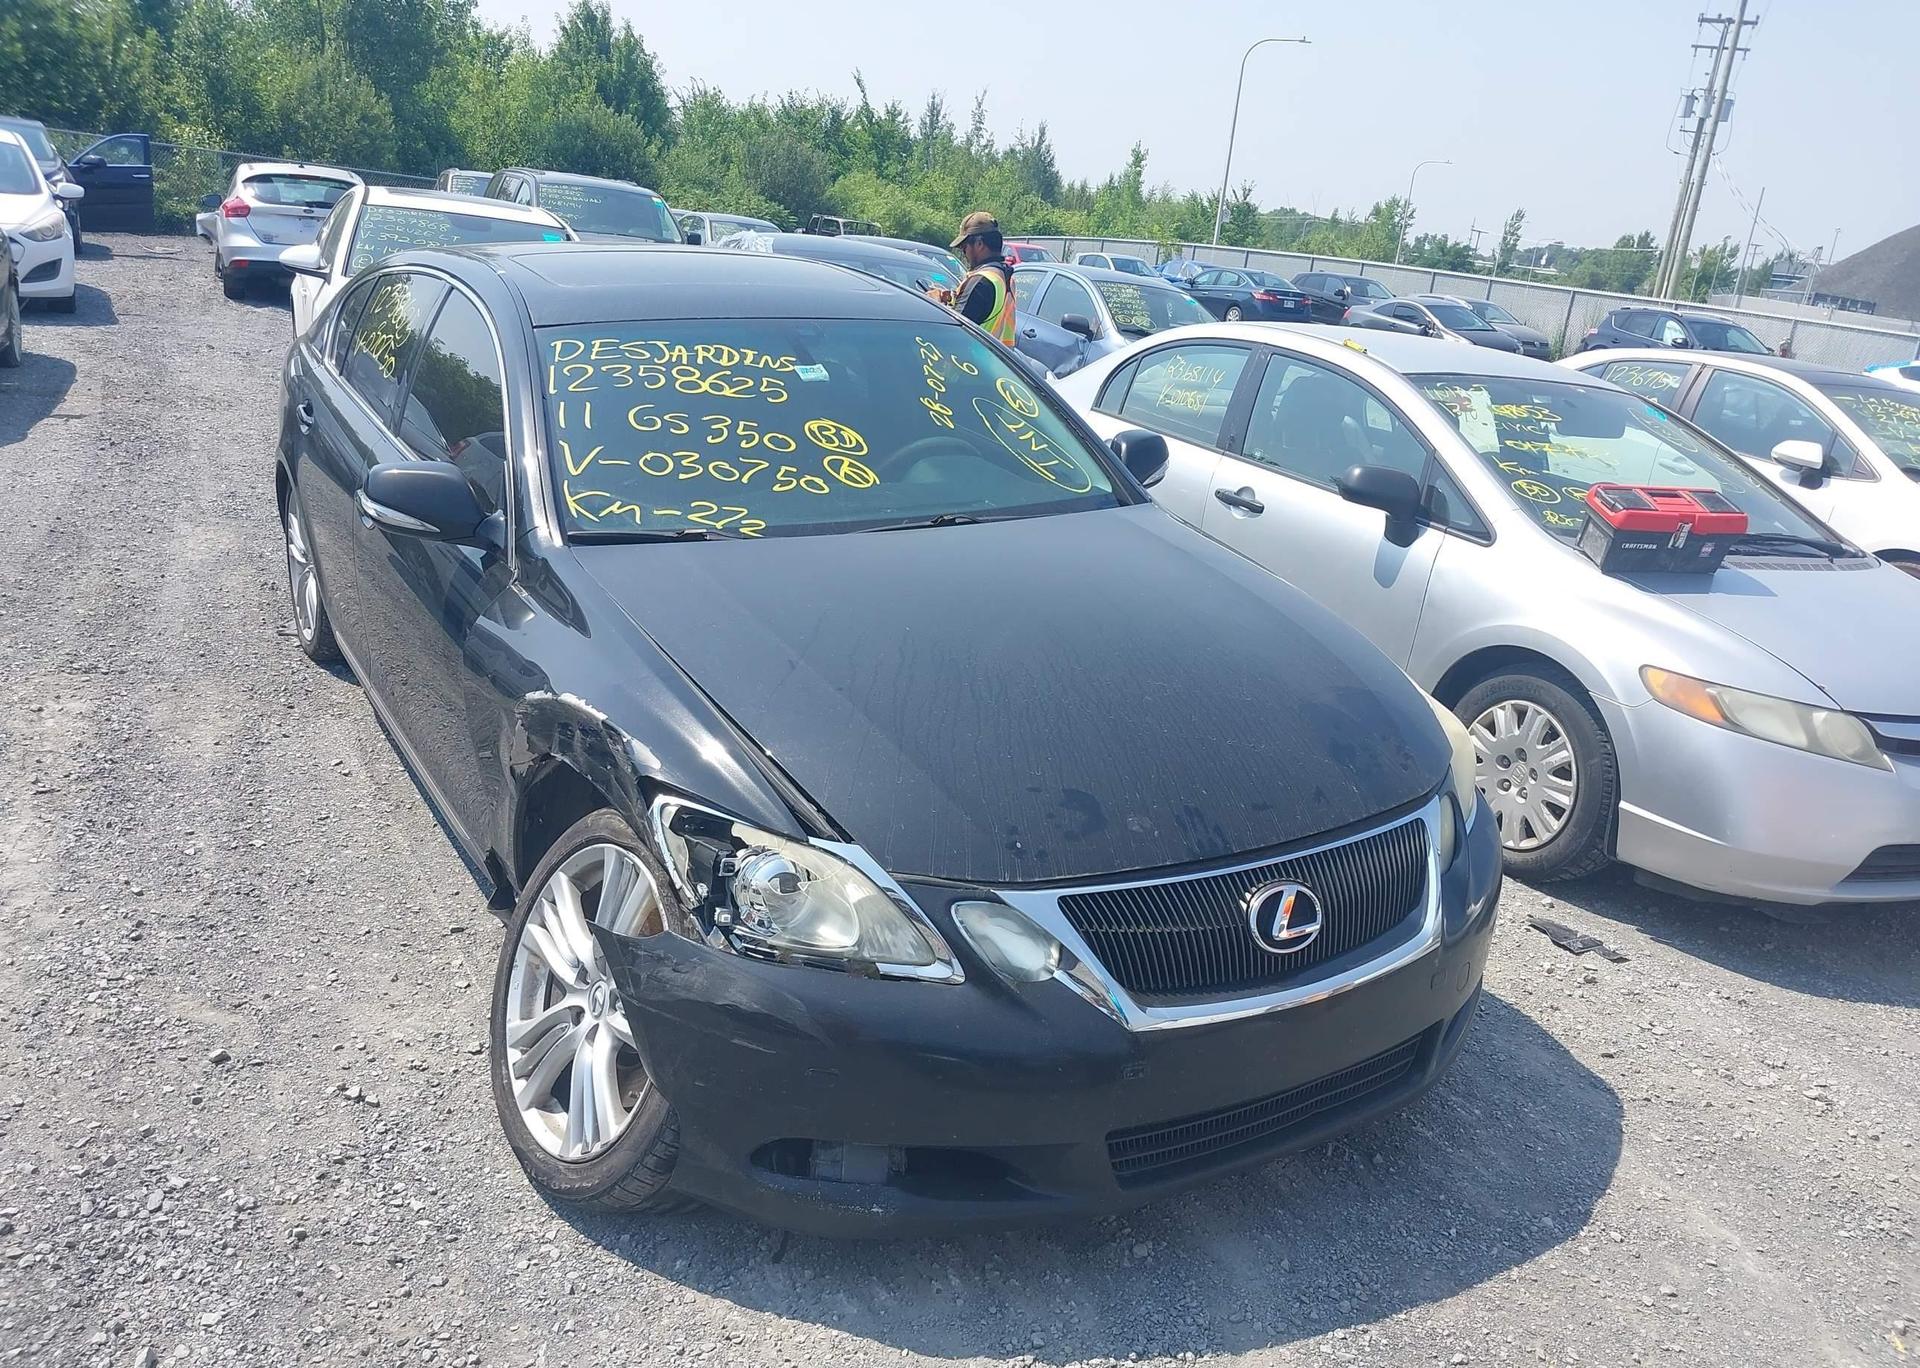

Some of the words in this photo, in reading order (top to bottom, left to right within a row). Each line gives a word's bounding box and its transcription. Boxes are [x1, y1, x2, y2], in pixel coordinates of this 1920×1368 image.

[550, 338, 797, 373] DESJARDINS
[548, 363, 789, 404] 12358625
[558, 400, 592, 430] 11
[627, 403, 690, 434] GS
[701, 414, 797, 452] 350
[558, 439, 831, 495] V-030750
[1621, 542, 1658, 550] CRAFTSMAN
